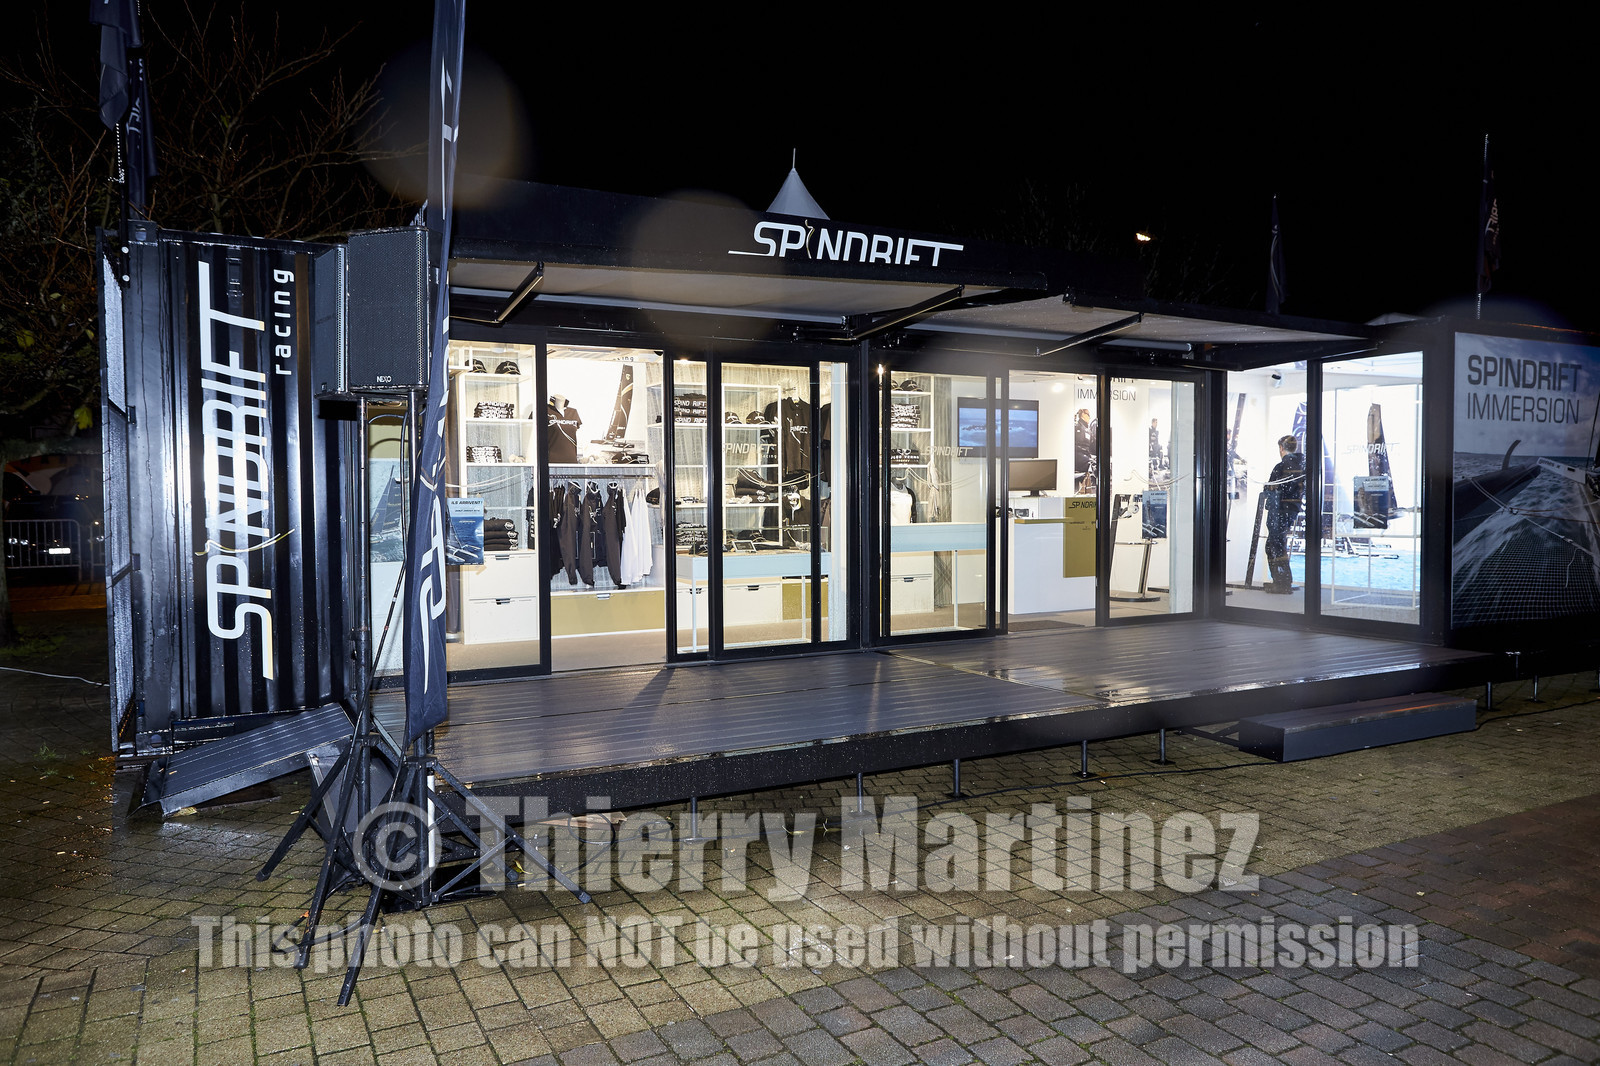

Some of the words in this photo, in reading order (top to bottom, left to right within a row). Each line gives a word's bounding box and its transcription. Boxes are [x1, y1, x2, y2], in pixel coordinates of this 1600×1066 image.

[728, 220, 964, 267] SPINDRIFT
[273, 268, 295, 375] racing
[376, 375, 392, 383] NEXO
[1467, 354, 1582, 392] SPINDRIFT
[1077, 388, 1137, 401] IMMSION
[1467, 392, 1580, 424] IMMERSION
